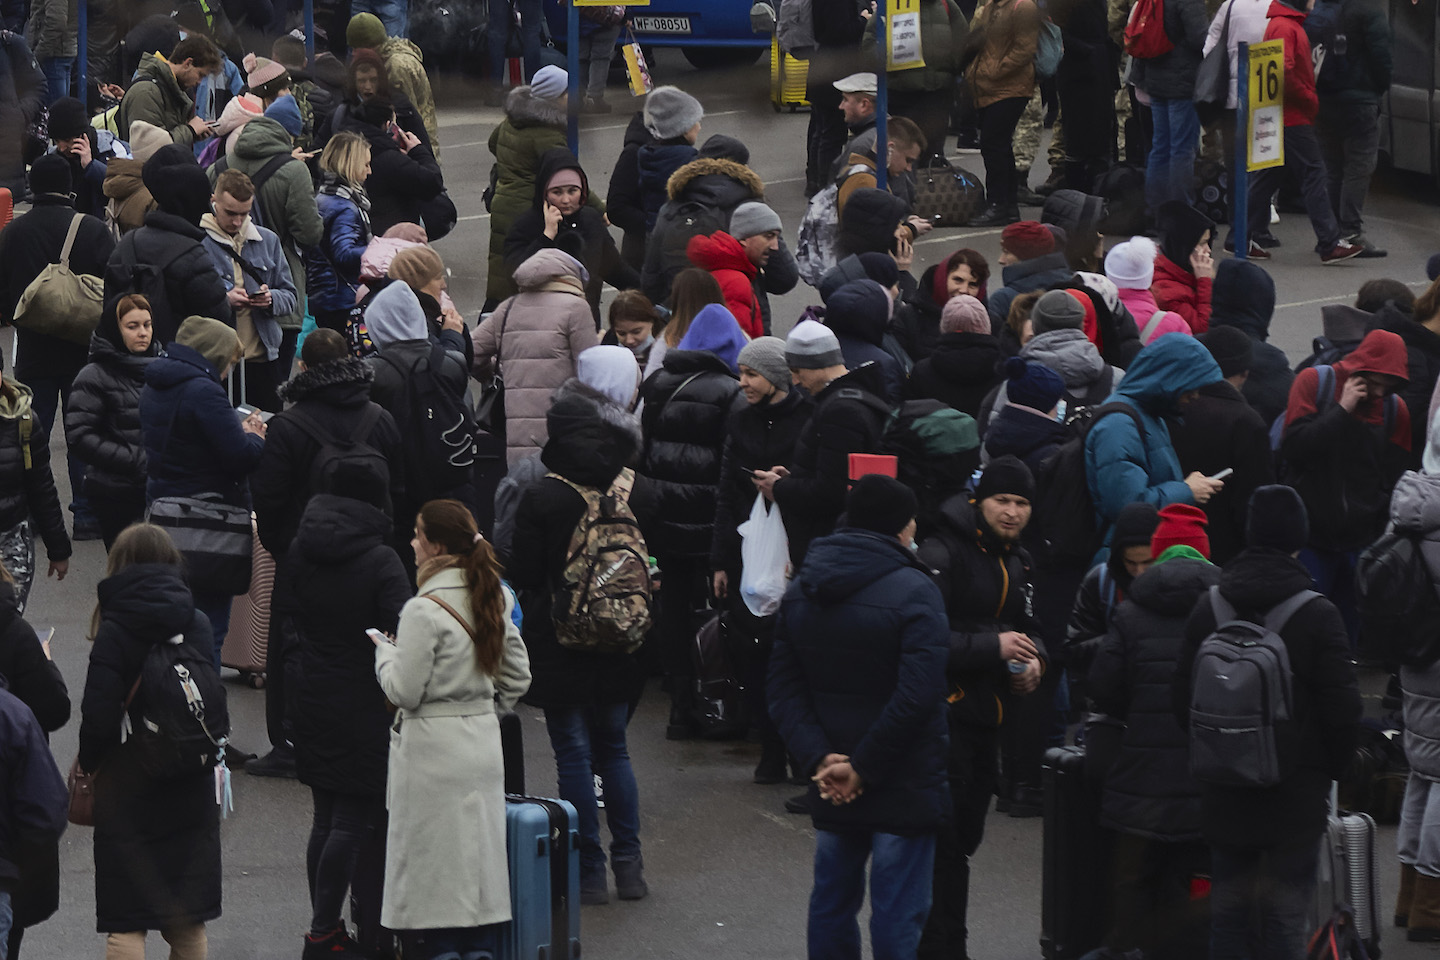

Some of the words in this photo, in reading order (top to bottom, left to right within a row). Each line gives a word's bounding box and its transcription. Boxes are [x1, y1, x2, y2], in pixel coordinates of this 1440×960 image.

[635, 20, 650, 29] WF
[654, 19, 689, 30] 0805U
[1256, 60, 1279, 103] 16
